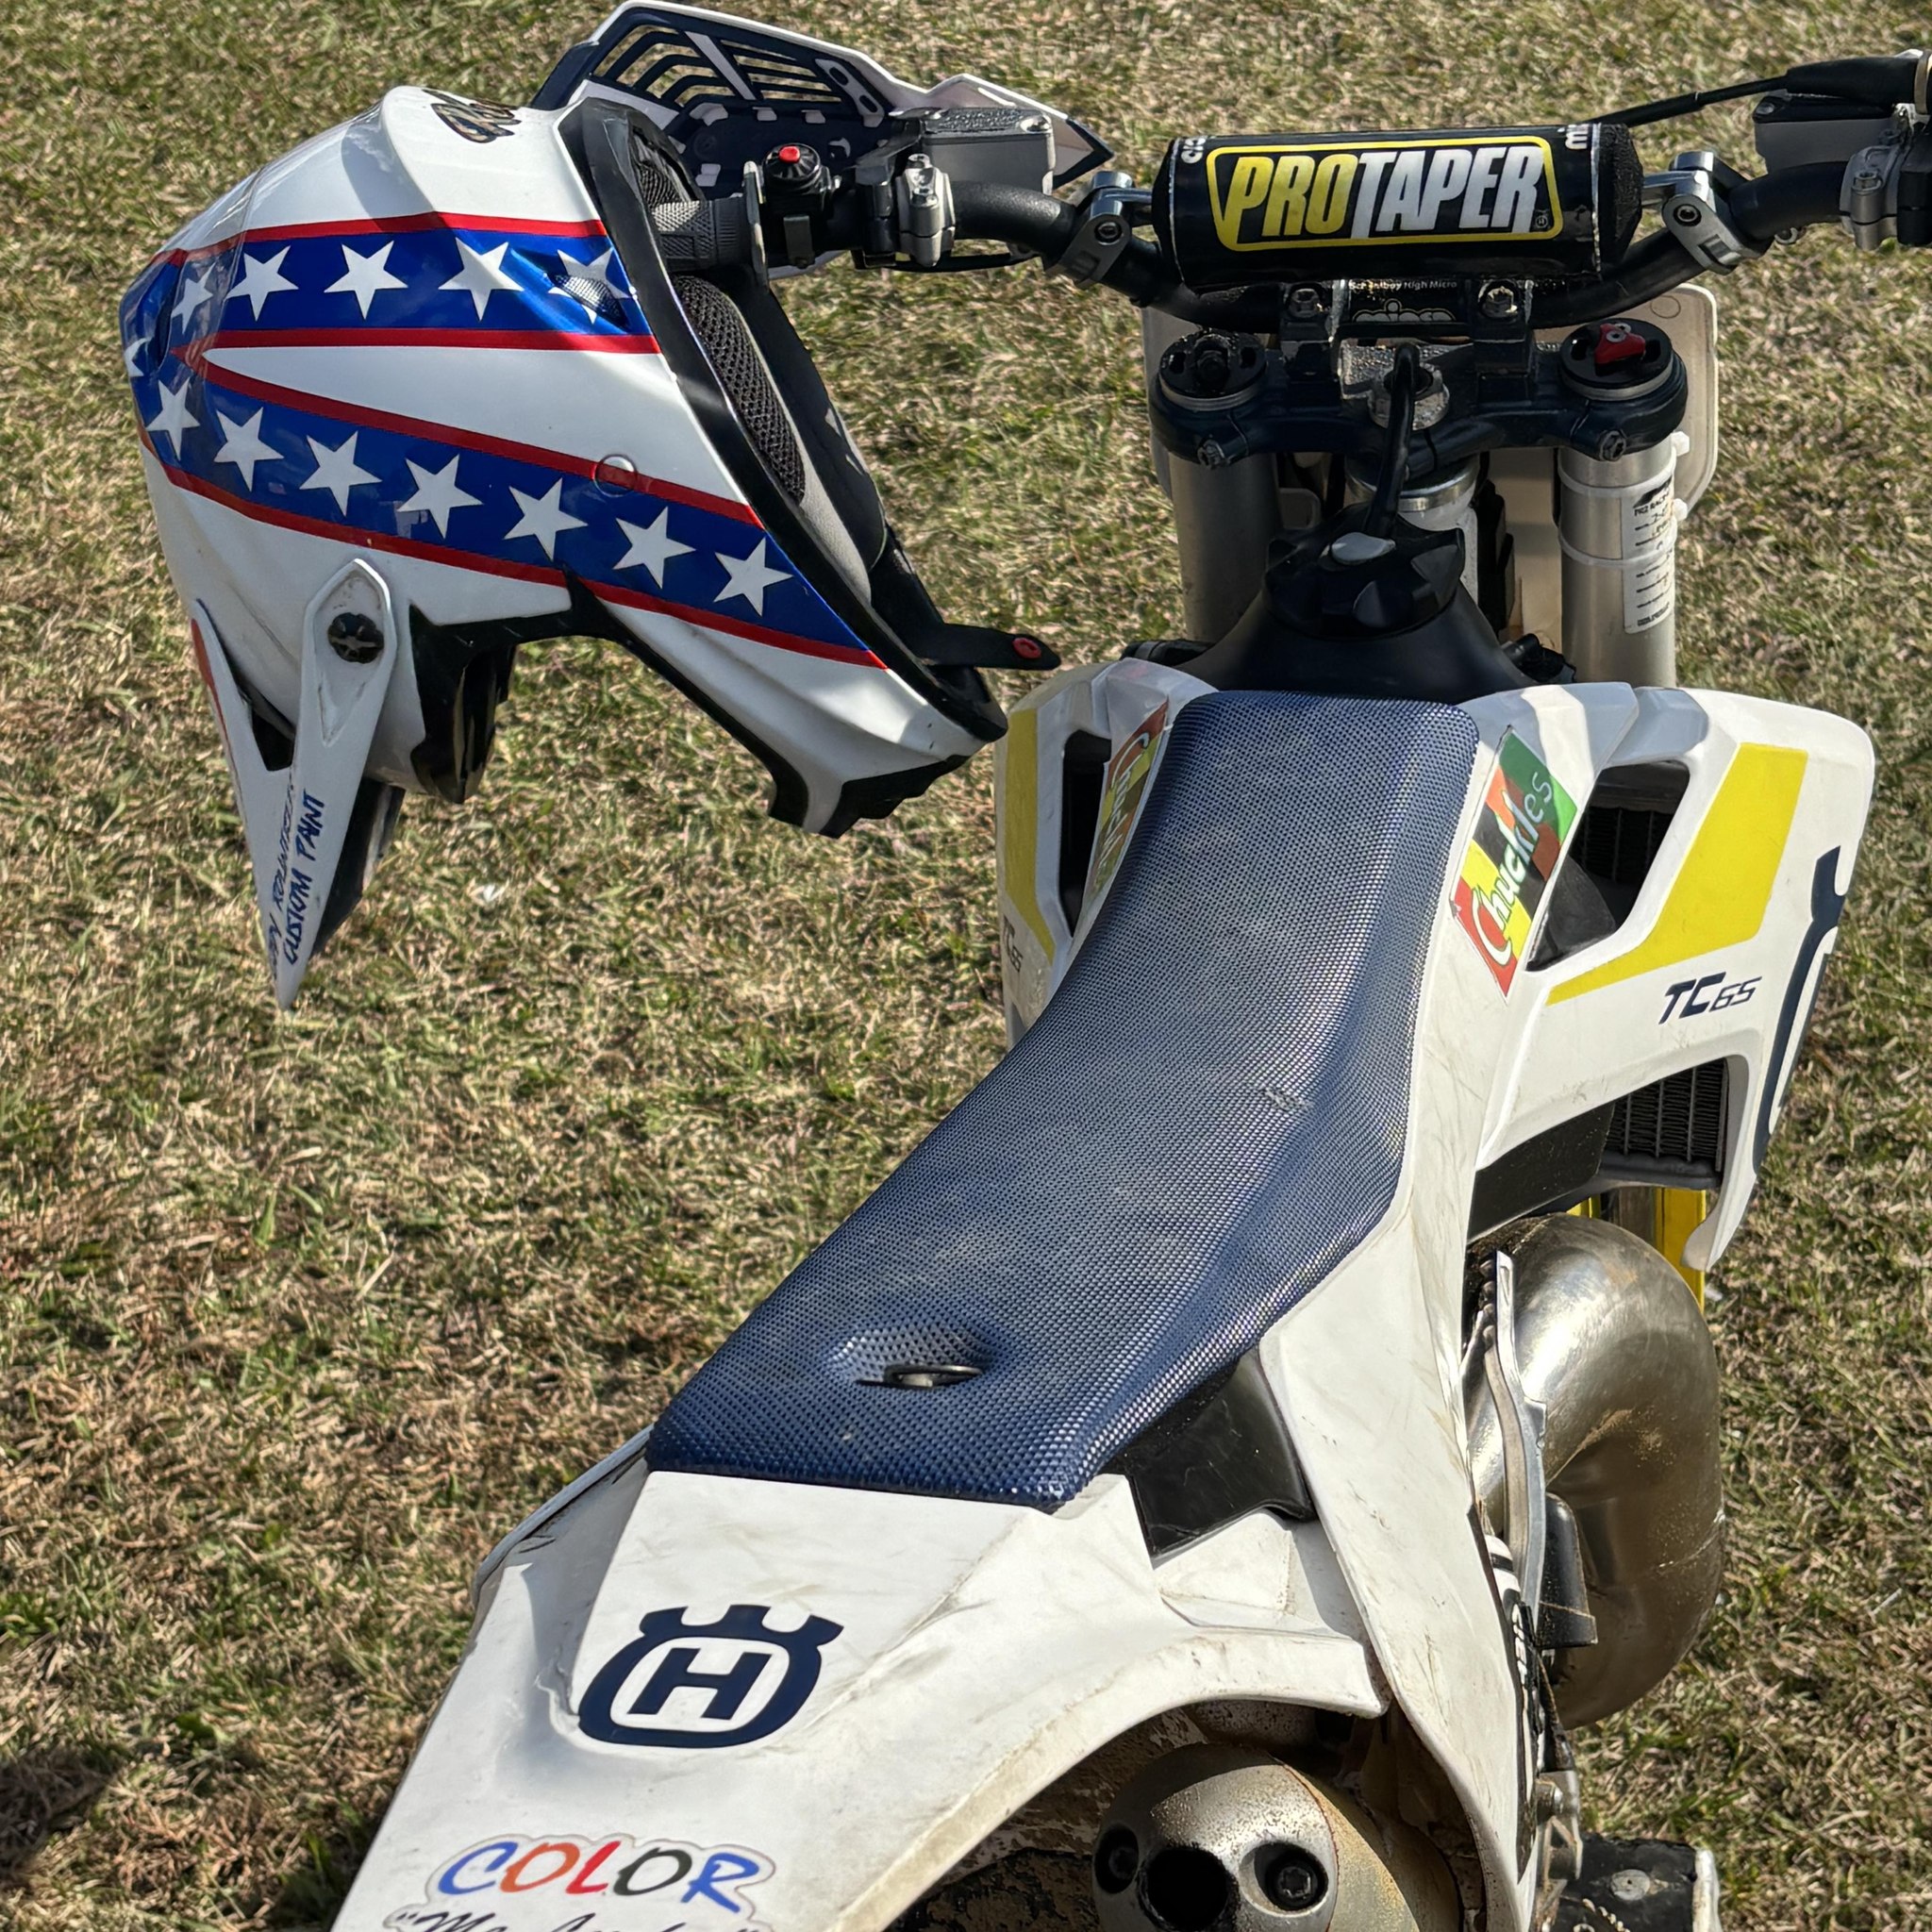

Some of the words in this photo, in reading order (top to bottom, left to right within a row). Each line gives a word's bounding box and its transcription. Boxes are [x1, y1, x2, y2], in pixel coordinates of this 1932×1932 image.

[1222, 145, 1545, 242] PROTAPER
[295, 789, 325, 861] PAINT
[1472, 772, 1552, 966] Chuckles
[283, 868, 312, 965] CUSTOM
[1658, 972, 1762, 1025] TC65
[438, 1840, 759, 1913] COLOR
